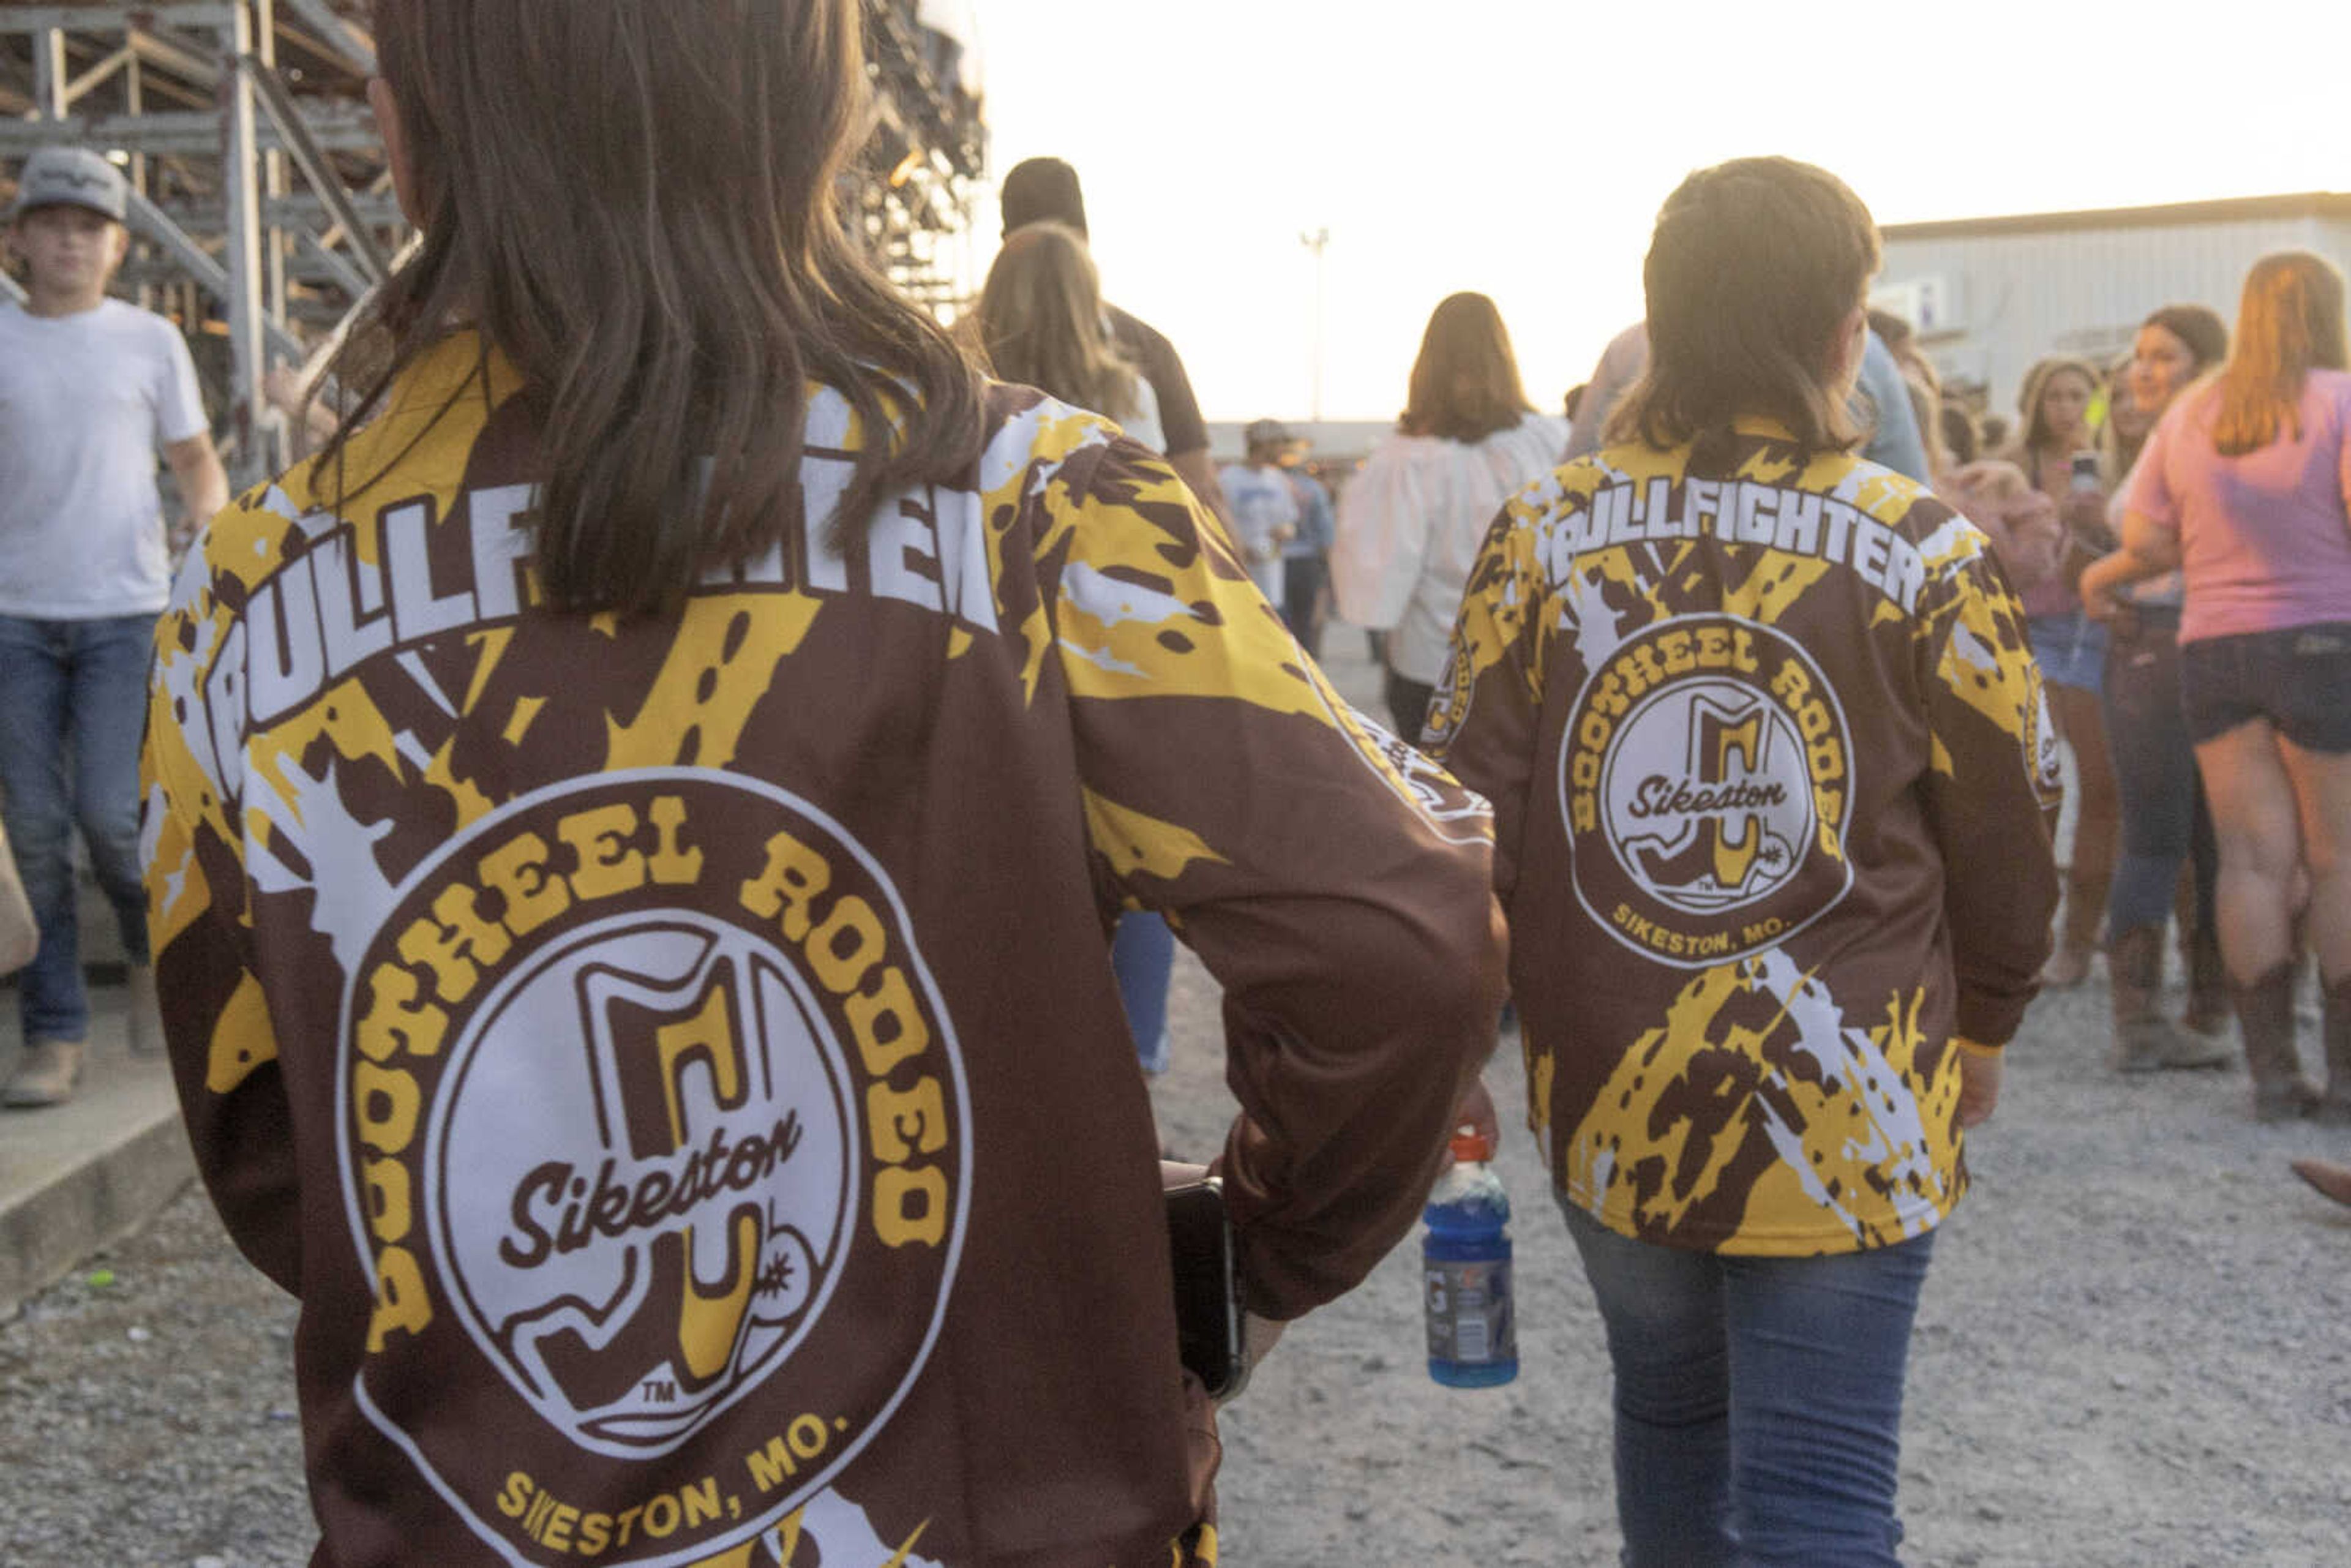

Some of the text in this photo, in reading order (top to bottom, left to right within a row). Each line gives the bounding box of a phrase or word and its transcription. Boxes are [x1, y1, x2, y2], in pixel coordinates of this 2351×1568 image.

[1551, 476, 1925, 617] BULLFIGHTER
[1628, 775, 1787, 819] Sikeston
[1742, 917, 1791, 943] MO.
[740, 831, 947, 1248] RODEO
[499, 1108, 803, 1269] Sikeston
[642, 1381, 676, 1402] TM
[745, 1413, 849, 1493] MO.
